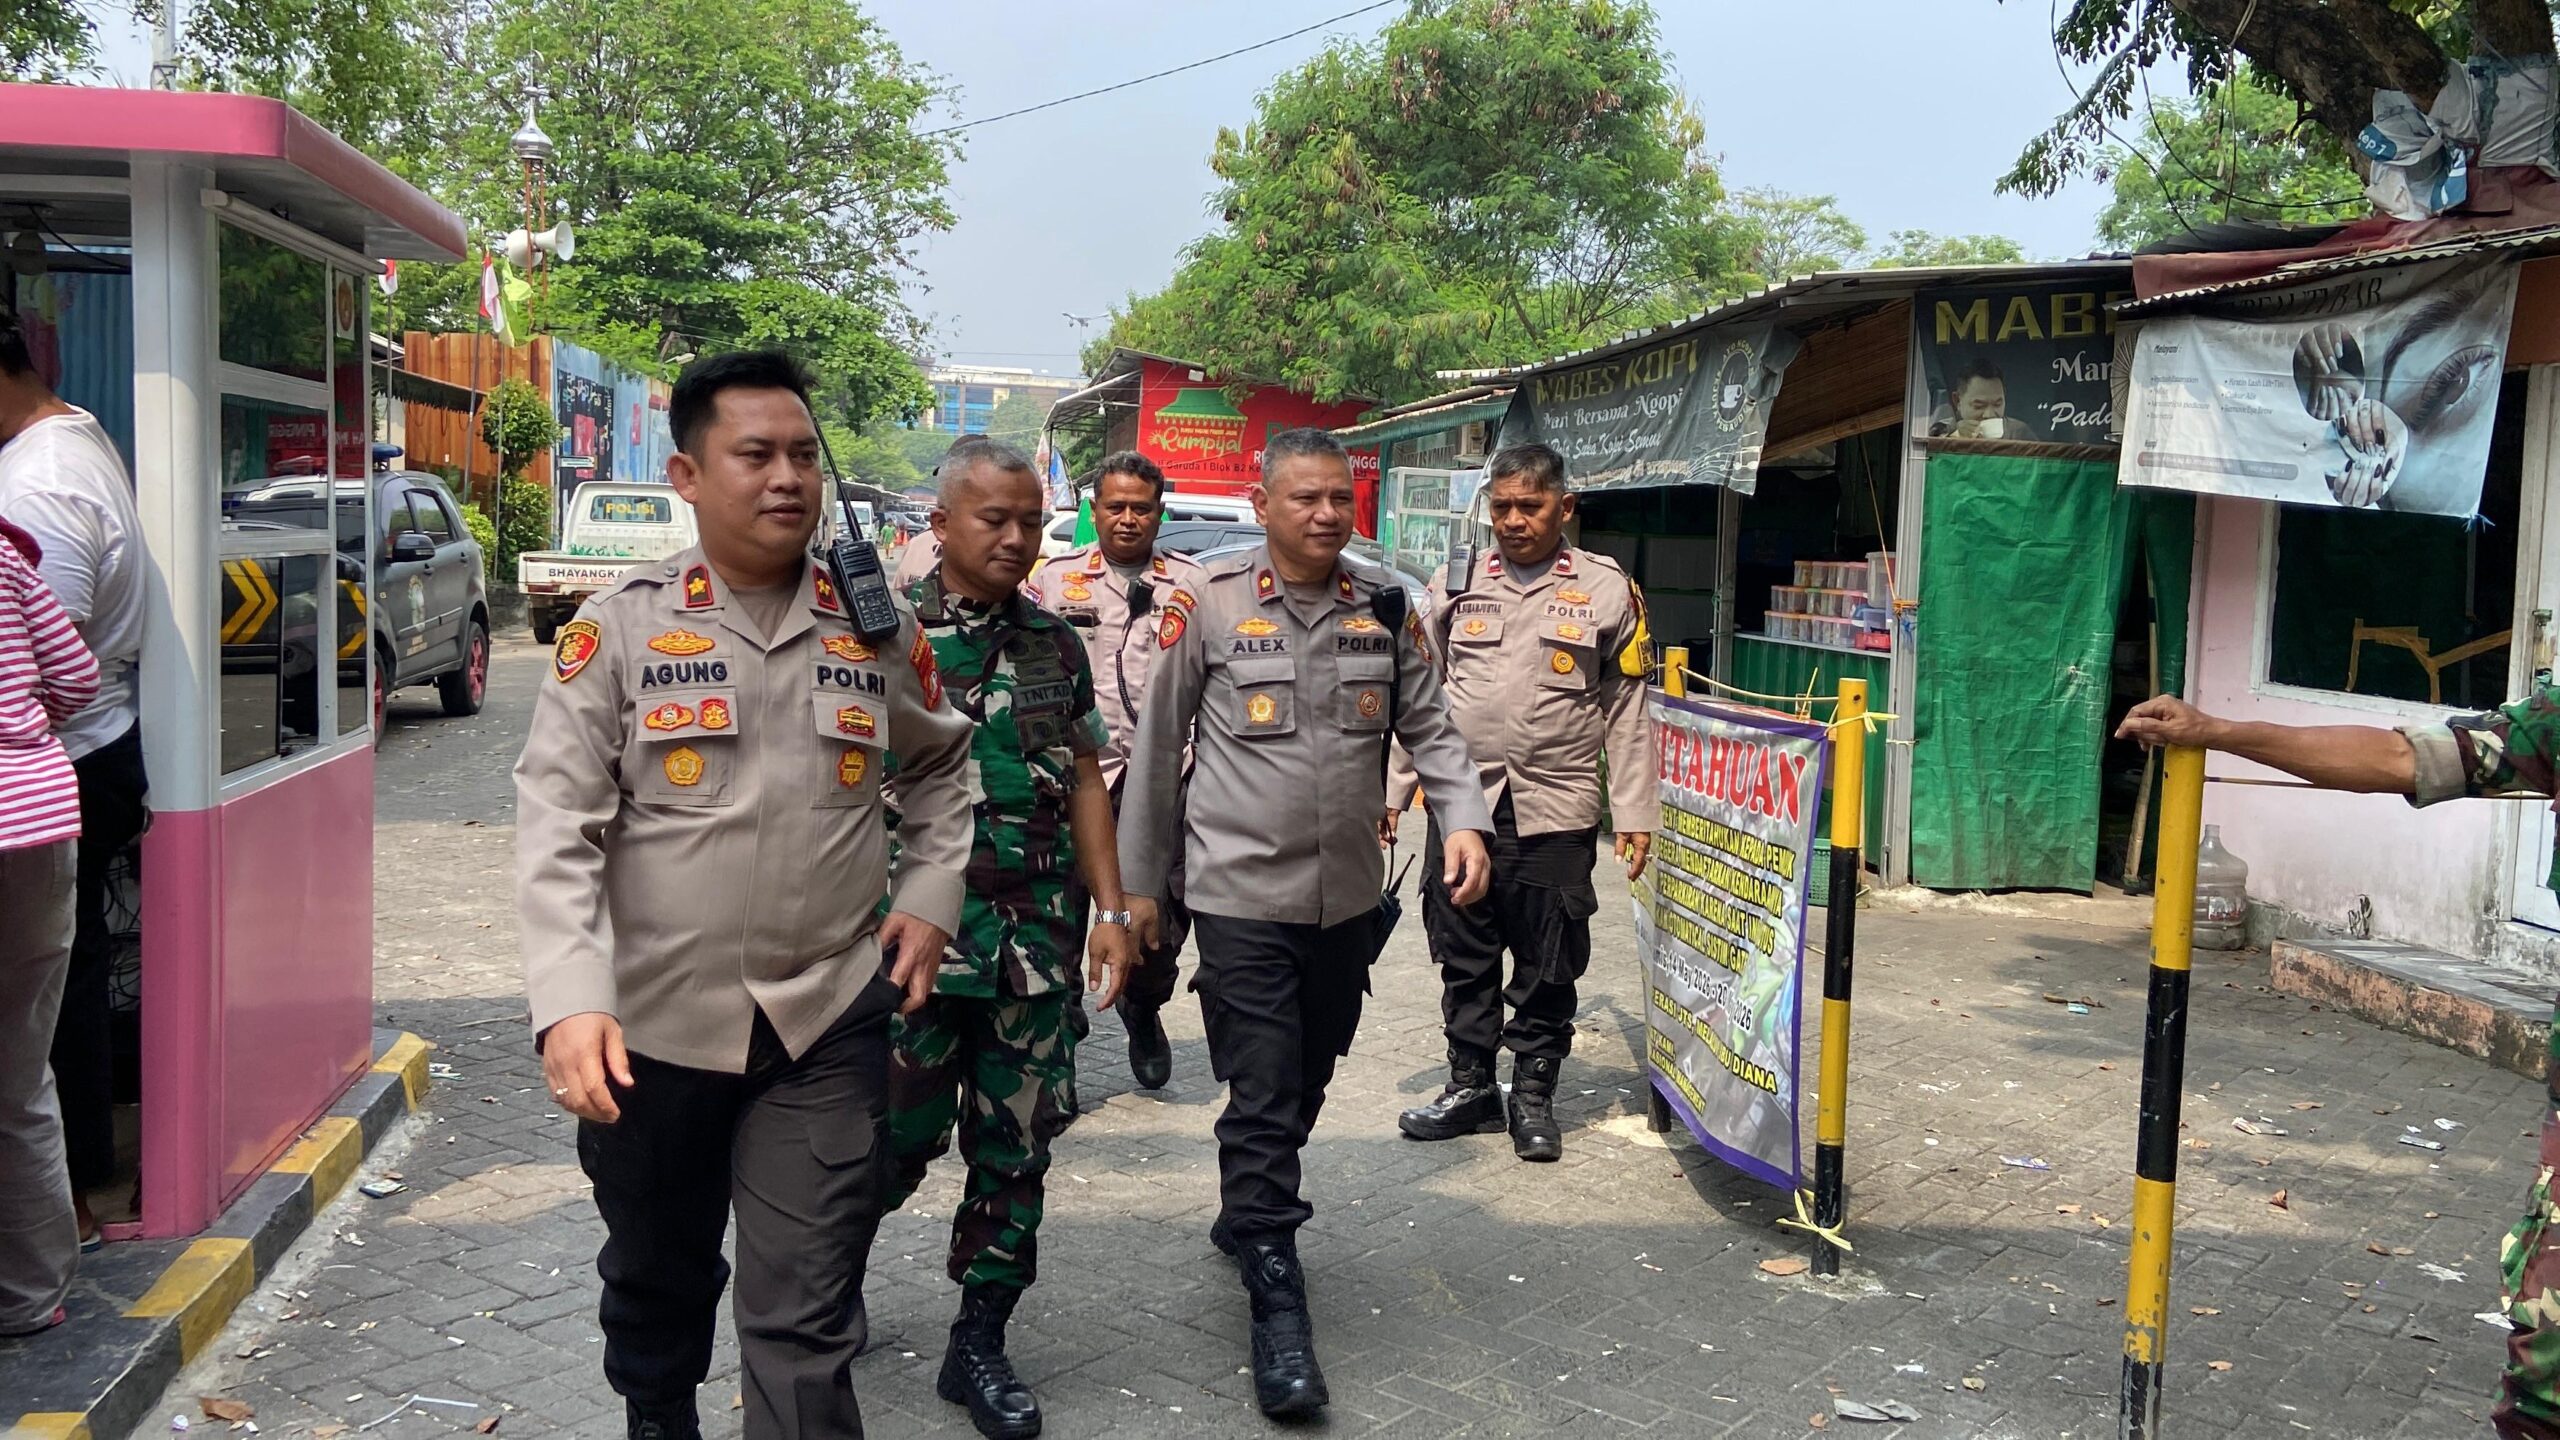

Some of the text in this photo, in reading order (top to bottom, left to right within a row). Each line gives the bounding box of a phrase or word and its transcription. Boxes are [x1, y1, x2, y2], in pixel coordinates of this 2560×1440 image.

[1536, 338, 1699, 407] MABES KOPI
[1574, 404, 1628, 426] Bersama
[1633, 387, 1684, 419] Ngopi
[1167, 461, 1200, 471] Garuda
[1209, 462, 1231, 471] Blok
[1233, 464, 1245, 473] B2
[1349, 455, 1381, 470] NGGI
[606, 502, 656, 515] POLISI
[1547, 605, 1594, 618] POLRI
[1233, 638, 1286, 653] ALEX
[1338, 636, 1388, 651] POLRI
[641, 660, 728, 689] AGUNG
[817, 665, 886, 696] POLRI
[1022, 684, 1070, 704] TNI AD
[1653, 720, 1808, 828] ITAHUAN
[1727, 904, 1747, 939] SAAT
[1693, 966, 1712, 1000] 2026
[1731, 1052, 1779, 1095] DIANA
